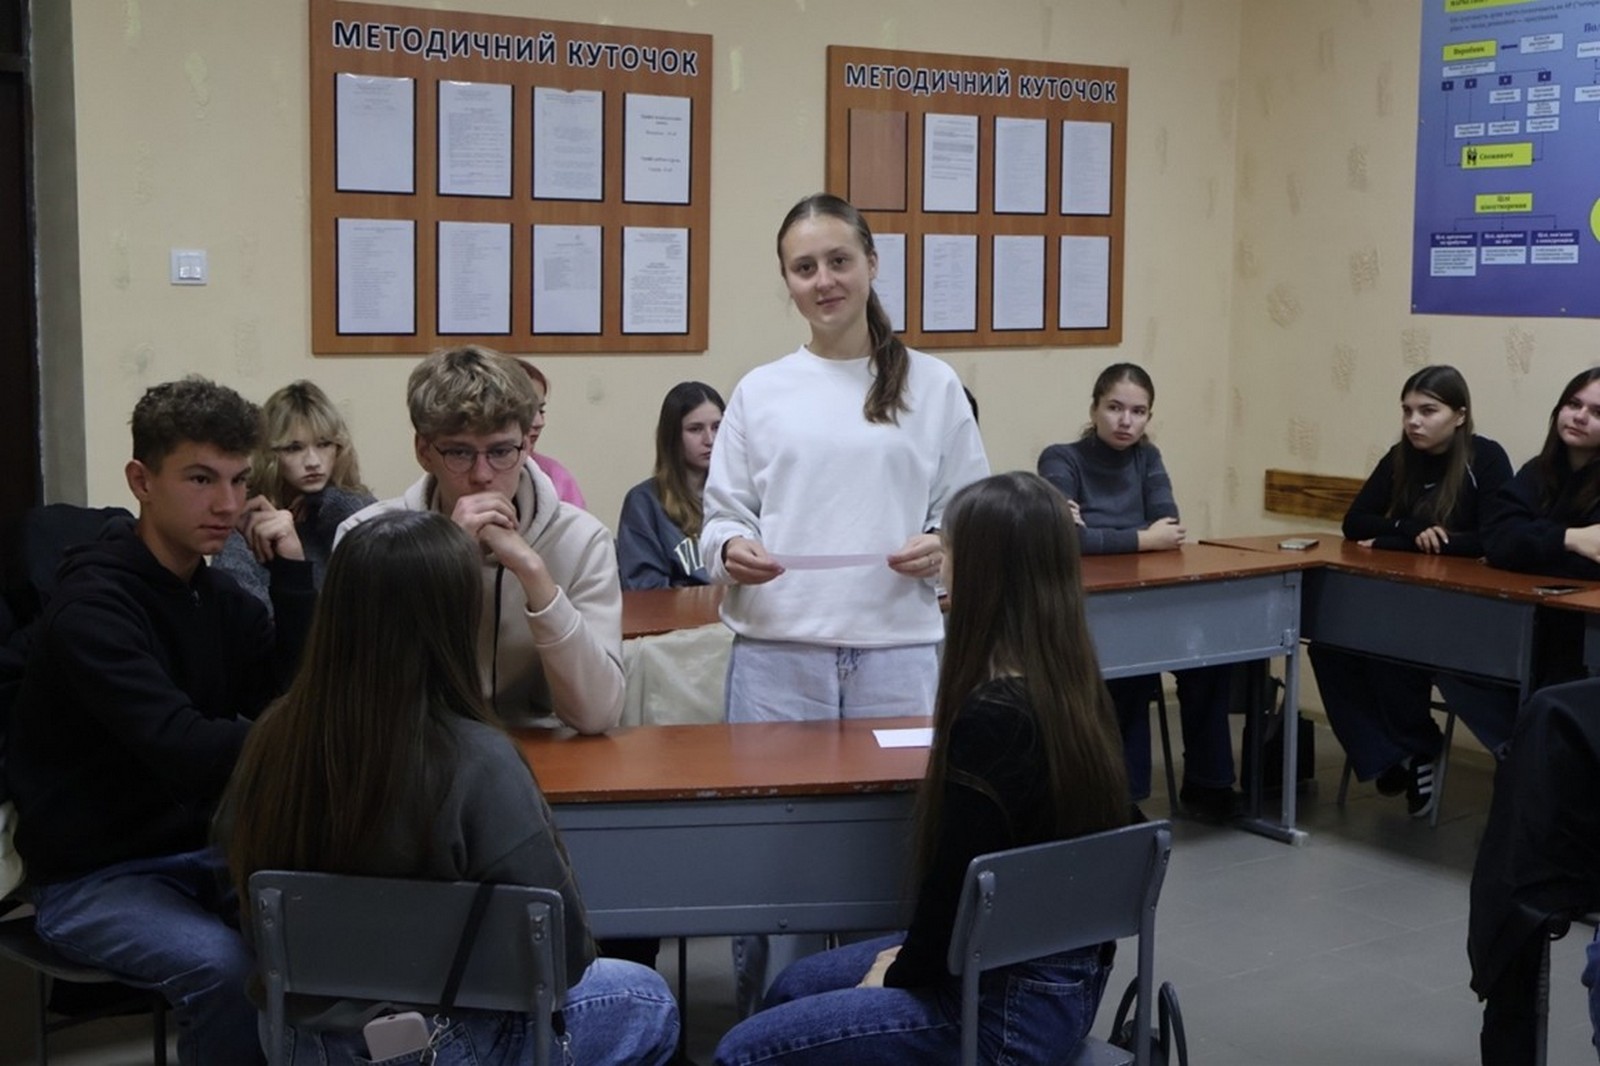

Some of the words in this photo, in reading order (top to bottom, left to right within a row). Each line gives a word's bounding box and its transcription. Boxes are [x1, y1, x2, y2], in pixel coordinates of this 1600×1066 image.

[333, 20, 557, 64] МЕТОДИЧНИЙ
[568, 40, 699, 76] КУТОЧОК
[845, 62, 1011, 97] МЕТОДИЧНИЙ
[1018, 75, 1118, 103] КУТОЧОК
